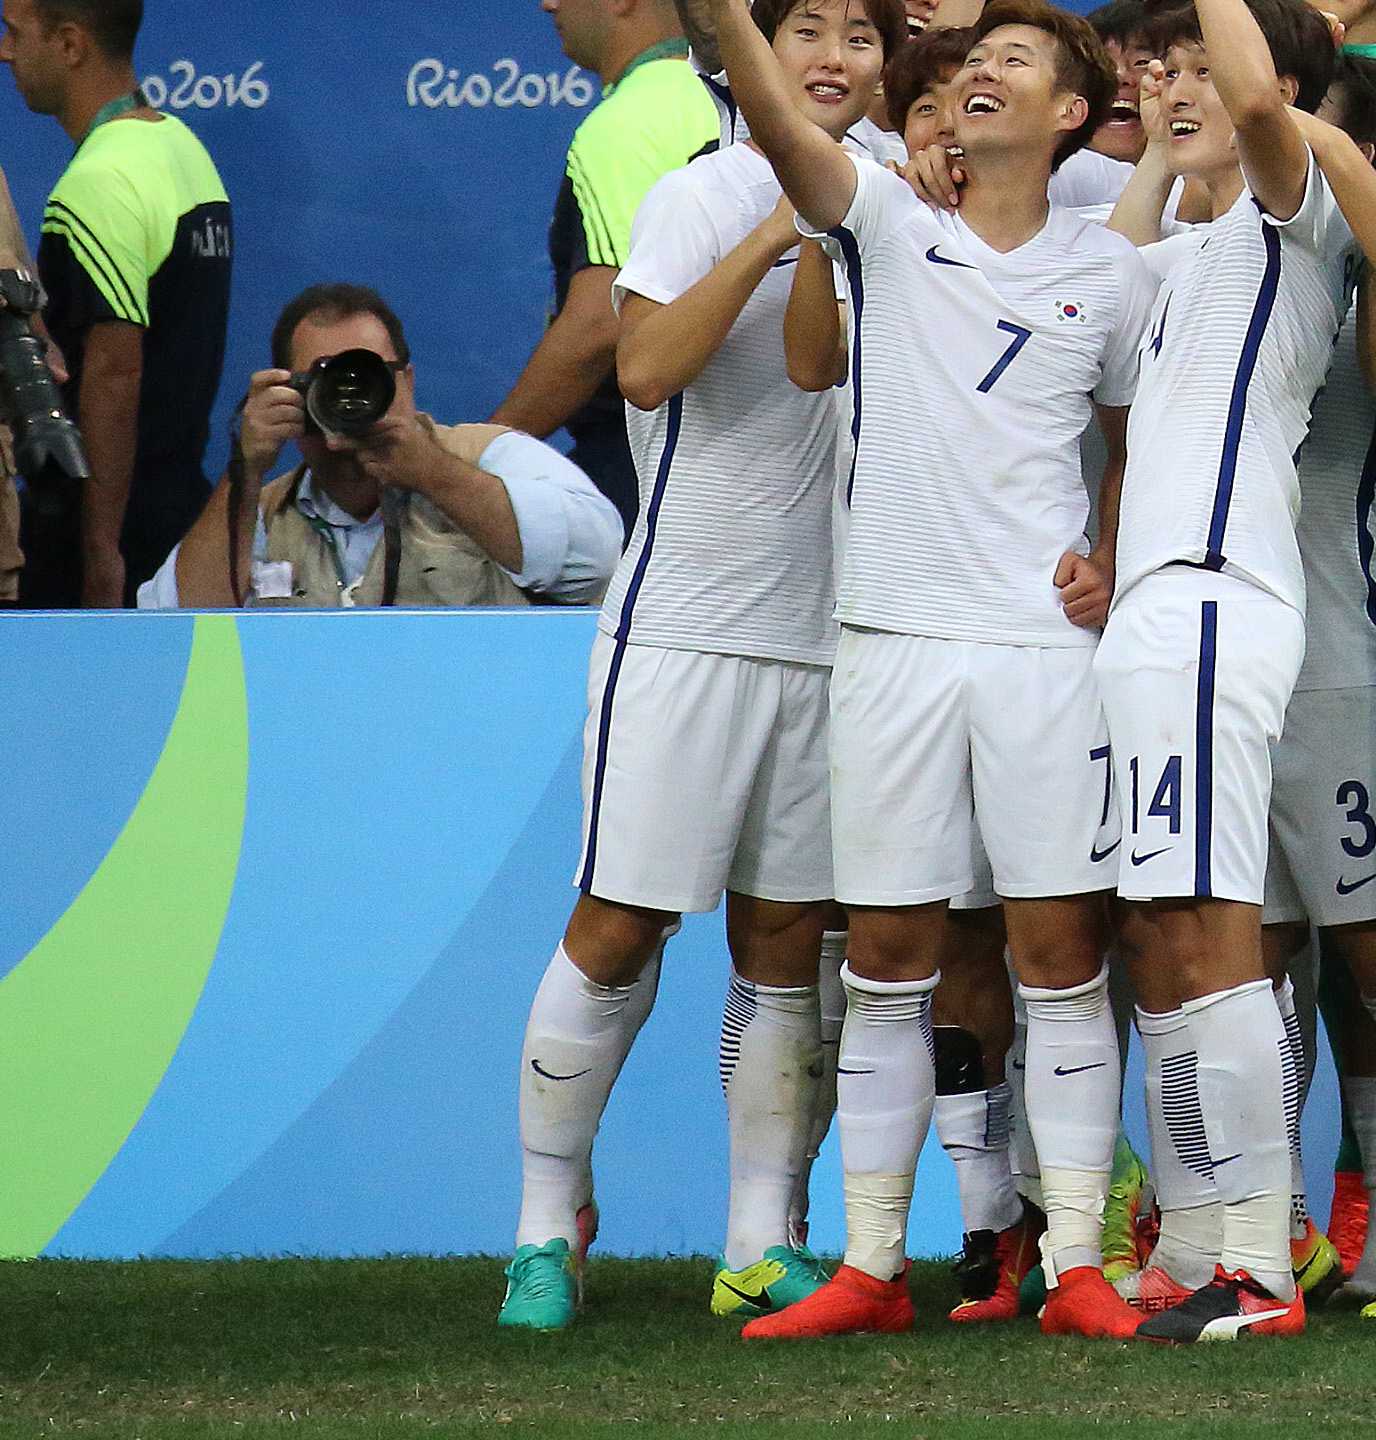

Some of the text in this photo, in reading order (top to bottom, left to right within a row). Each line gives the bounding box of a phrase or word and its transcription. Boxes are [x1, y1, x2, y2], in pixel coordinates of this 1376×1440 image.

[406, 57, 594, 108] Rio2016
[976, 318, 1033, 394] 7
[1090, 744, 1112, 828] 7
[1129, 754, 1182, 836] 14
